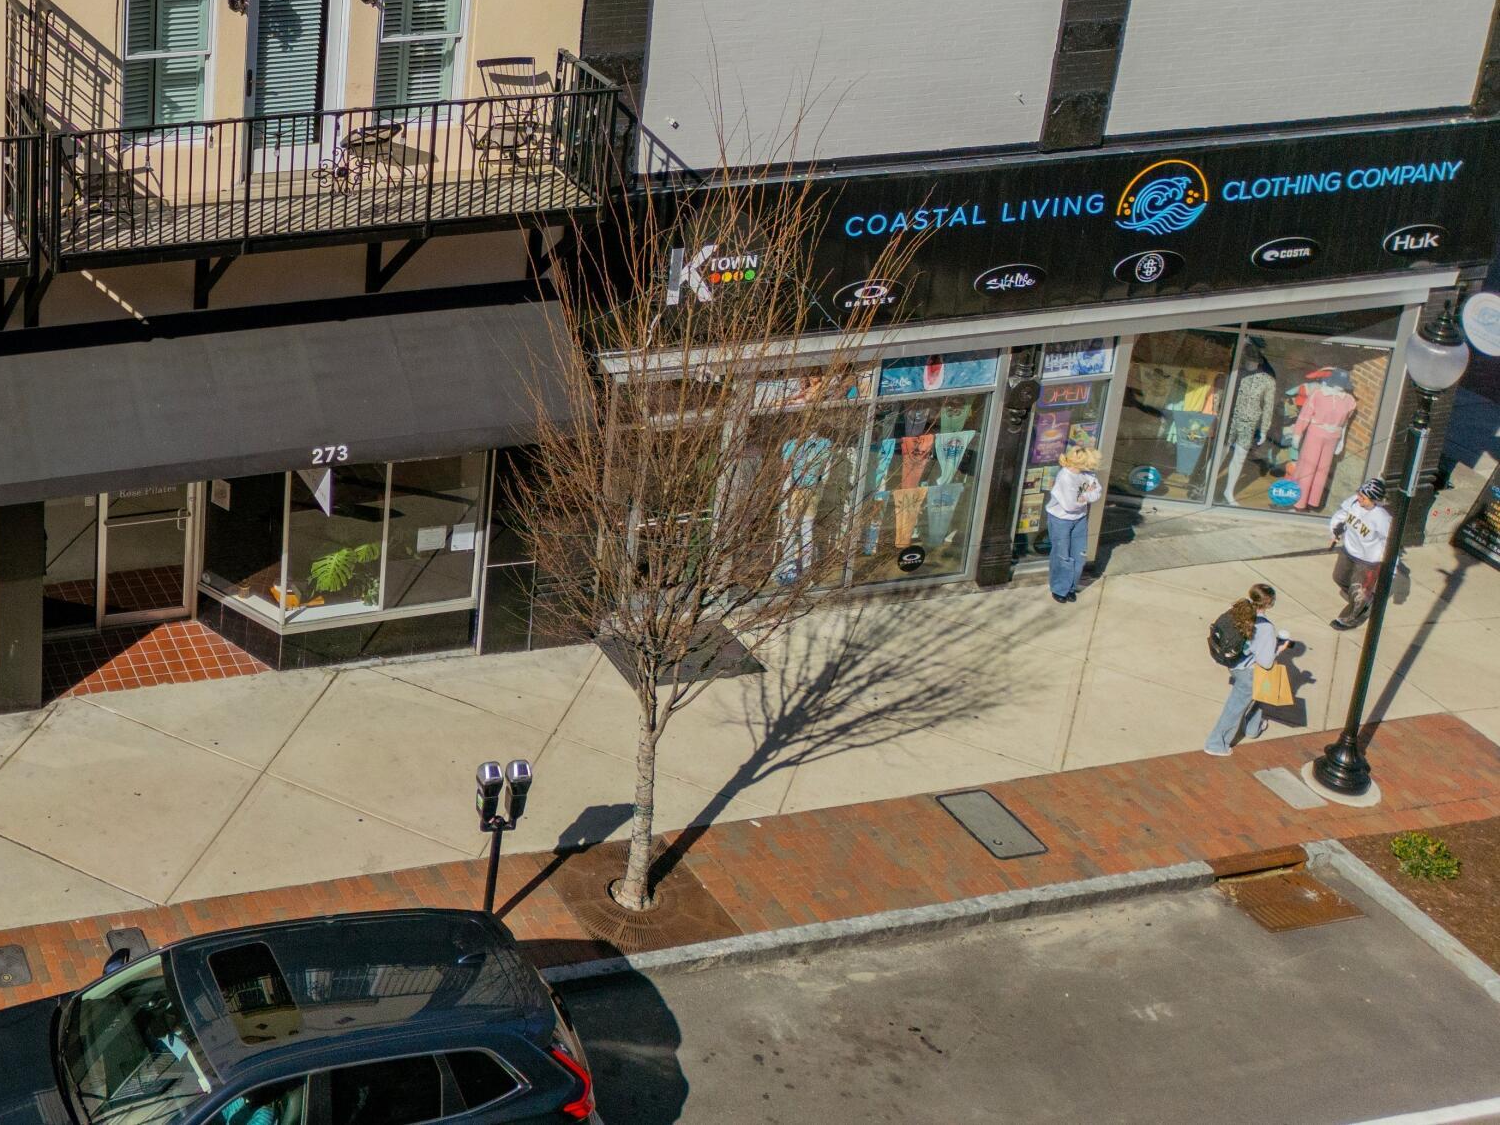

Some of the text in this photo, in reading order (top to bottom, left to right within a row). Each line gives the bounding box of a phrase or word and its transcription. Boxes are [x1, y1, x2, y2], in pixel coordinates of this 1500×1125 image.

[1222, 160, 1463, 201] CLOTHING COMPANY
[844, 193, 1104, 237] COASTAL LIVING
[1279, 247, 1311, 259] COSTA
[710, 254, 758, 272] TOWN
[845, 296, 896, 308] OAKLEY
[1043, 385, 1088, 404] OPEN
[311, 445, 349, 465] 273
